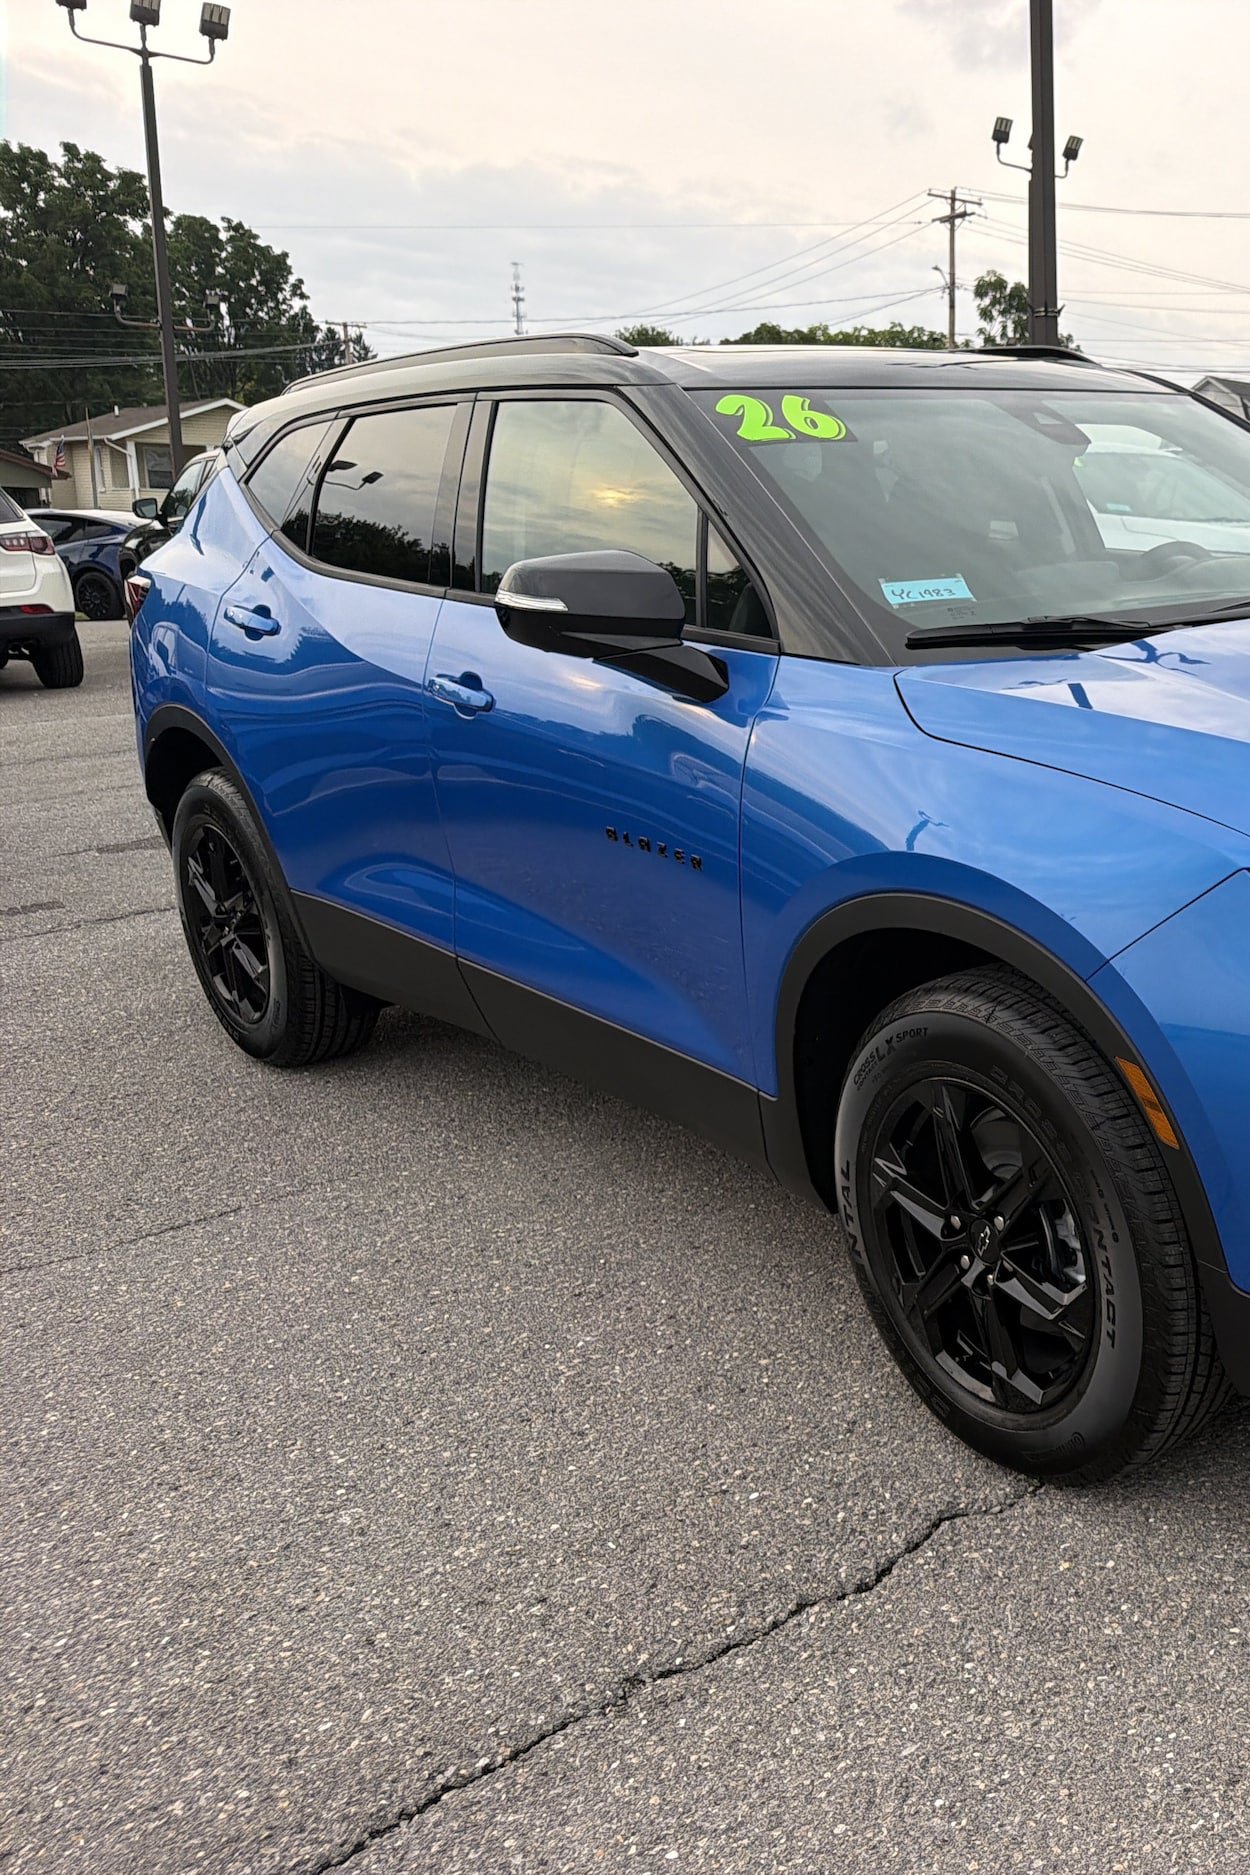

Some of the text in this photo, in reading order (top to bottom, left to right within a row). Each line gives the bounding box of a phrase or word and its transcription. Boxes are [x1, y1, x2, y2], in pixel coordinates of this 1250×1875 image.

[715, 394, 847, 441] 26
[606, 826, 703, 871] BLAZER
[896, 1027, 928, 1043] SPORT
